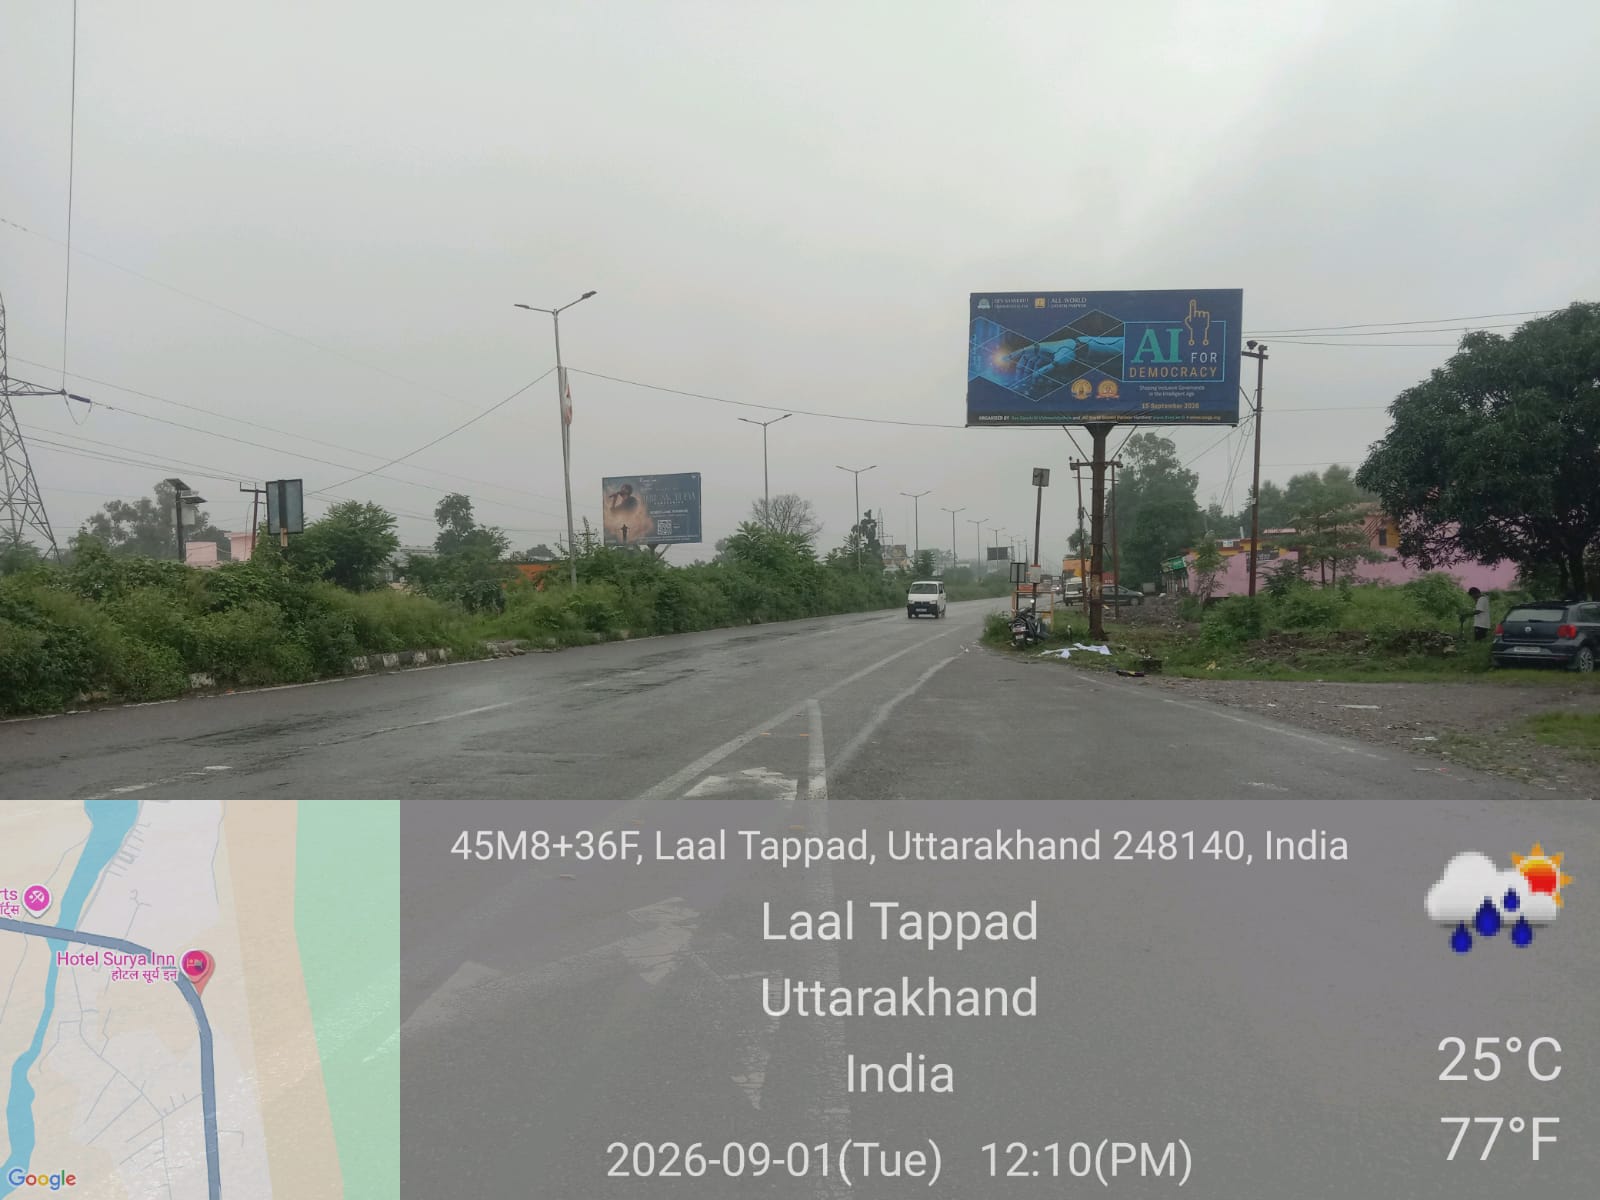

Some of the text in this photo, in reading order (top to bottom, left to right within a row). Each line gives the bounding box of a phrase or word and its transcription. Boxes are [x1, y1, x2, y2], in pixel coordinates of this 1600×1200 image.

[1131, 328, 1217, 364] AI FOR
[1129, 366, 1217, 378] DEMOCRACY
